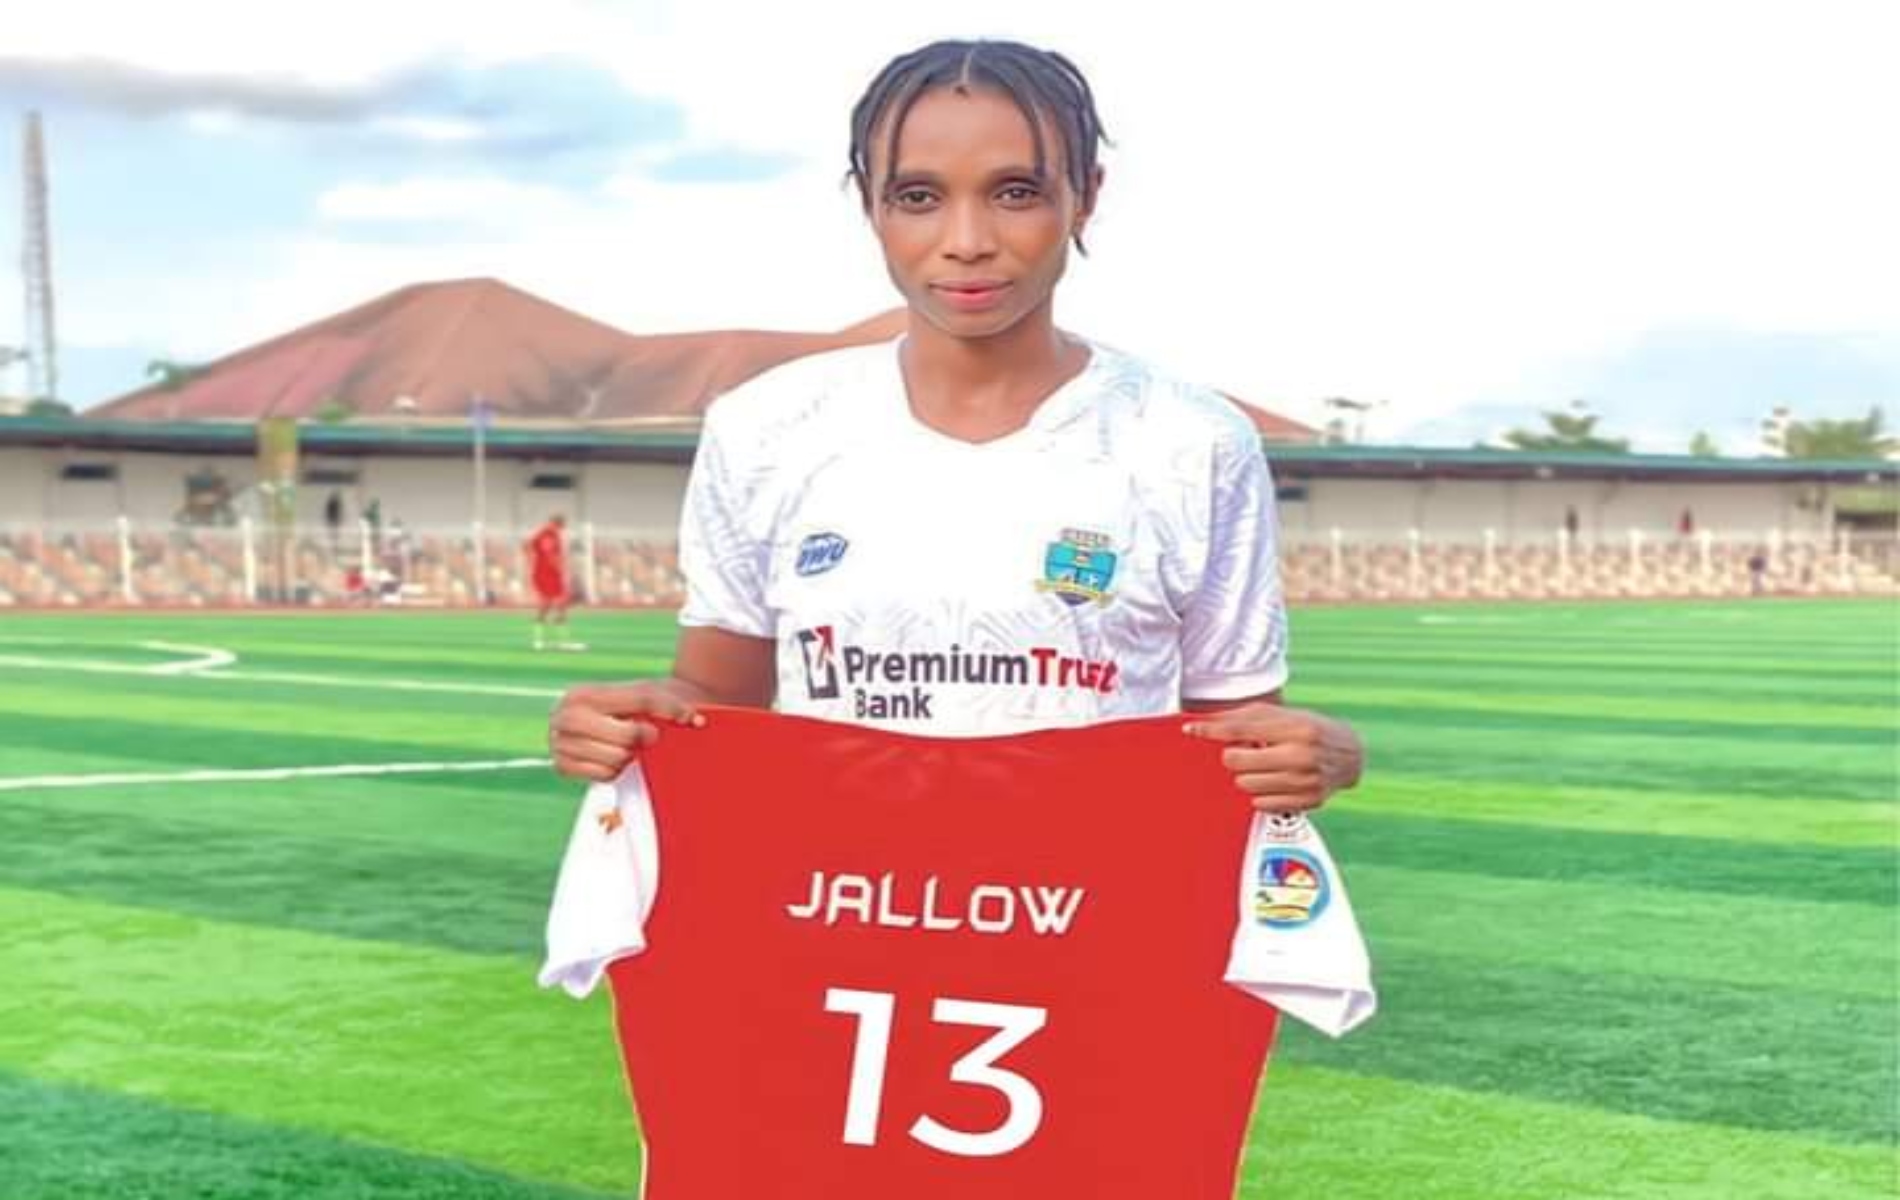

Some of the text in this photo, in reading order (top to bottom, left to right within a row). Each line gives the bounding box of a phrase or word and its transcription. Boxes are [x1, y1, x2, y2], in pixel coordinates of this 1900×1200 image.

[843, 644, 1118, 692] PremiumTrust
[855, 688, 932, 719] Bank
[786, 871, 1085, 934] JALLOW
[824, 987, 1047, 1157] 13
